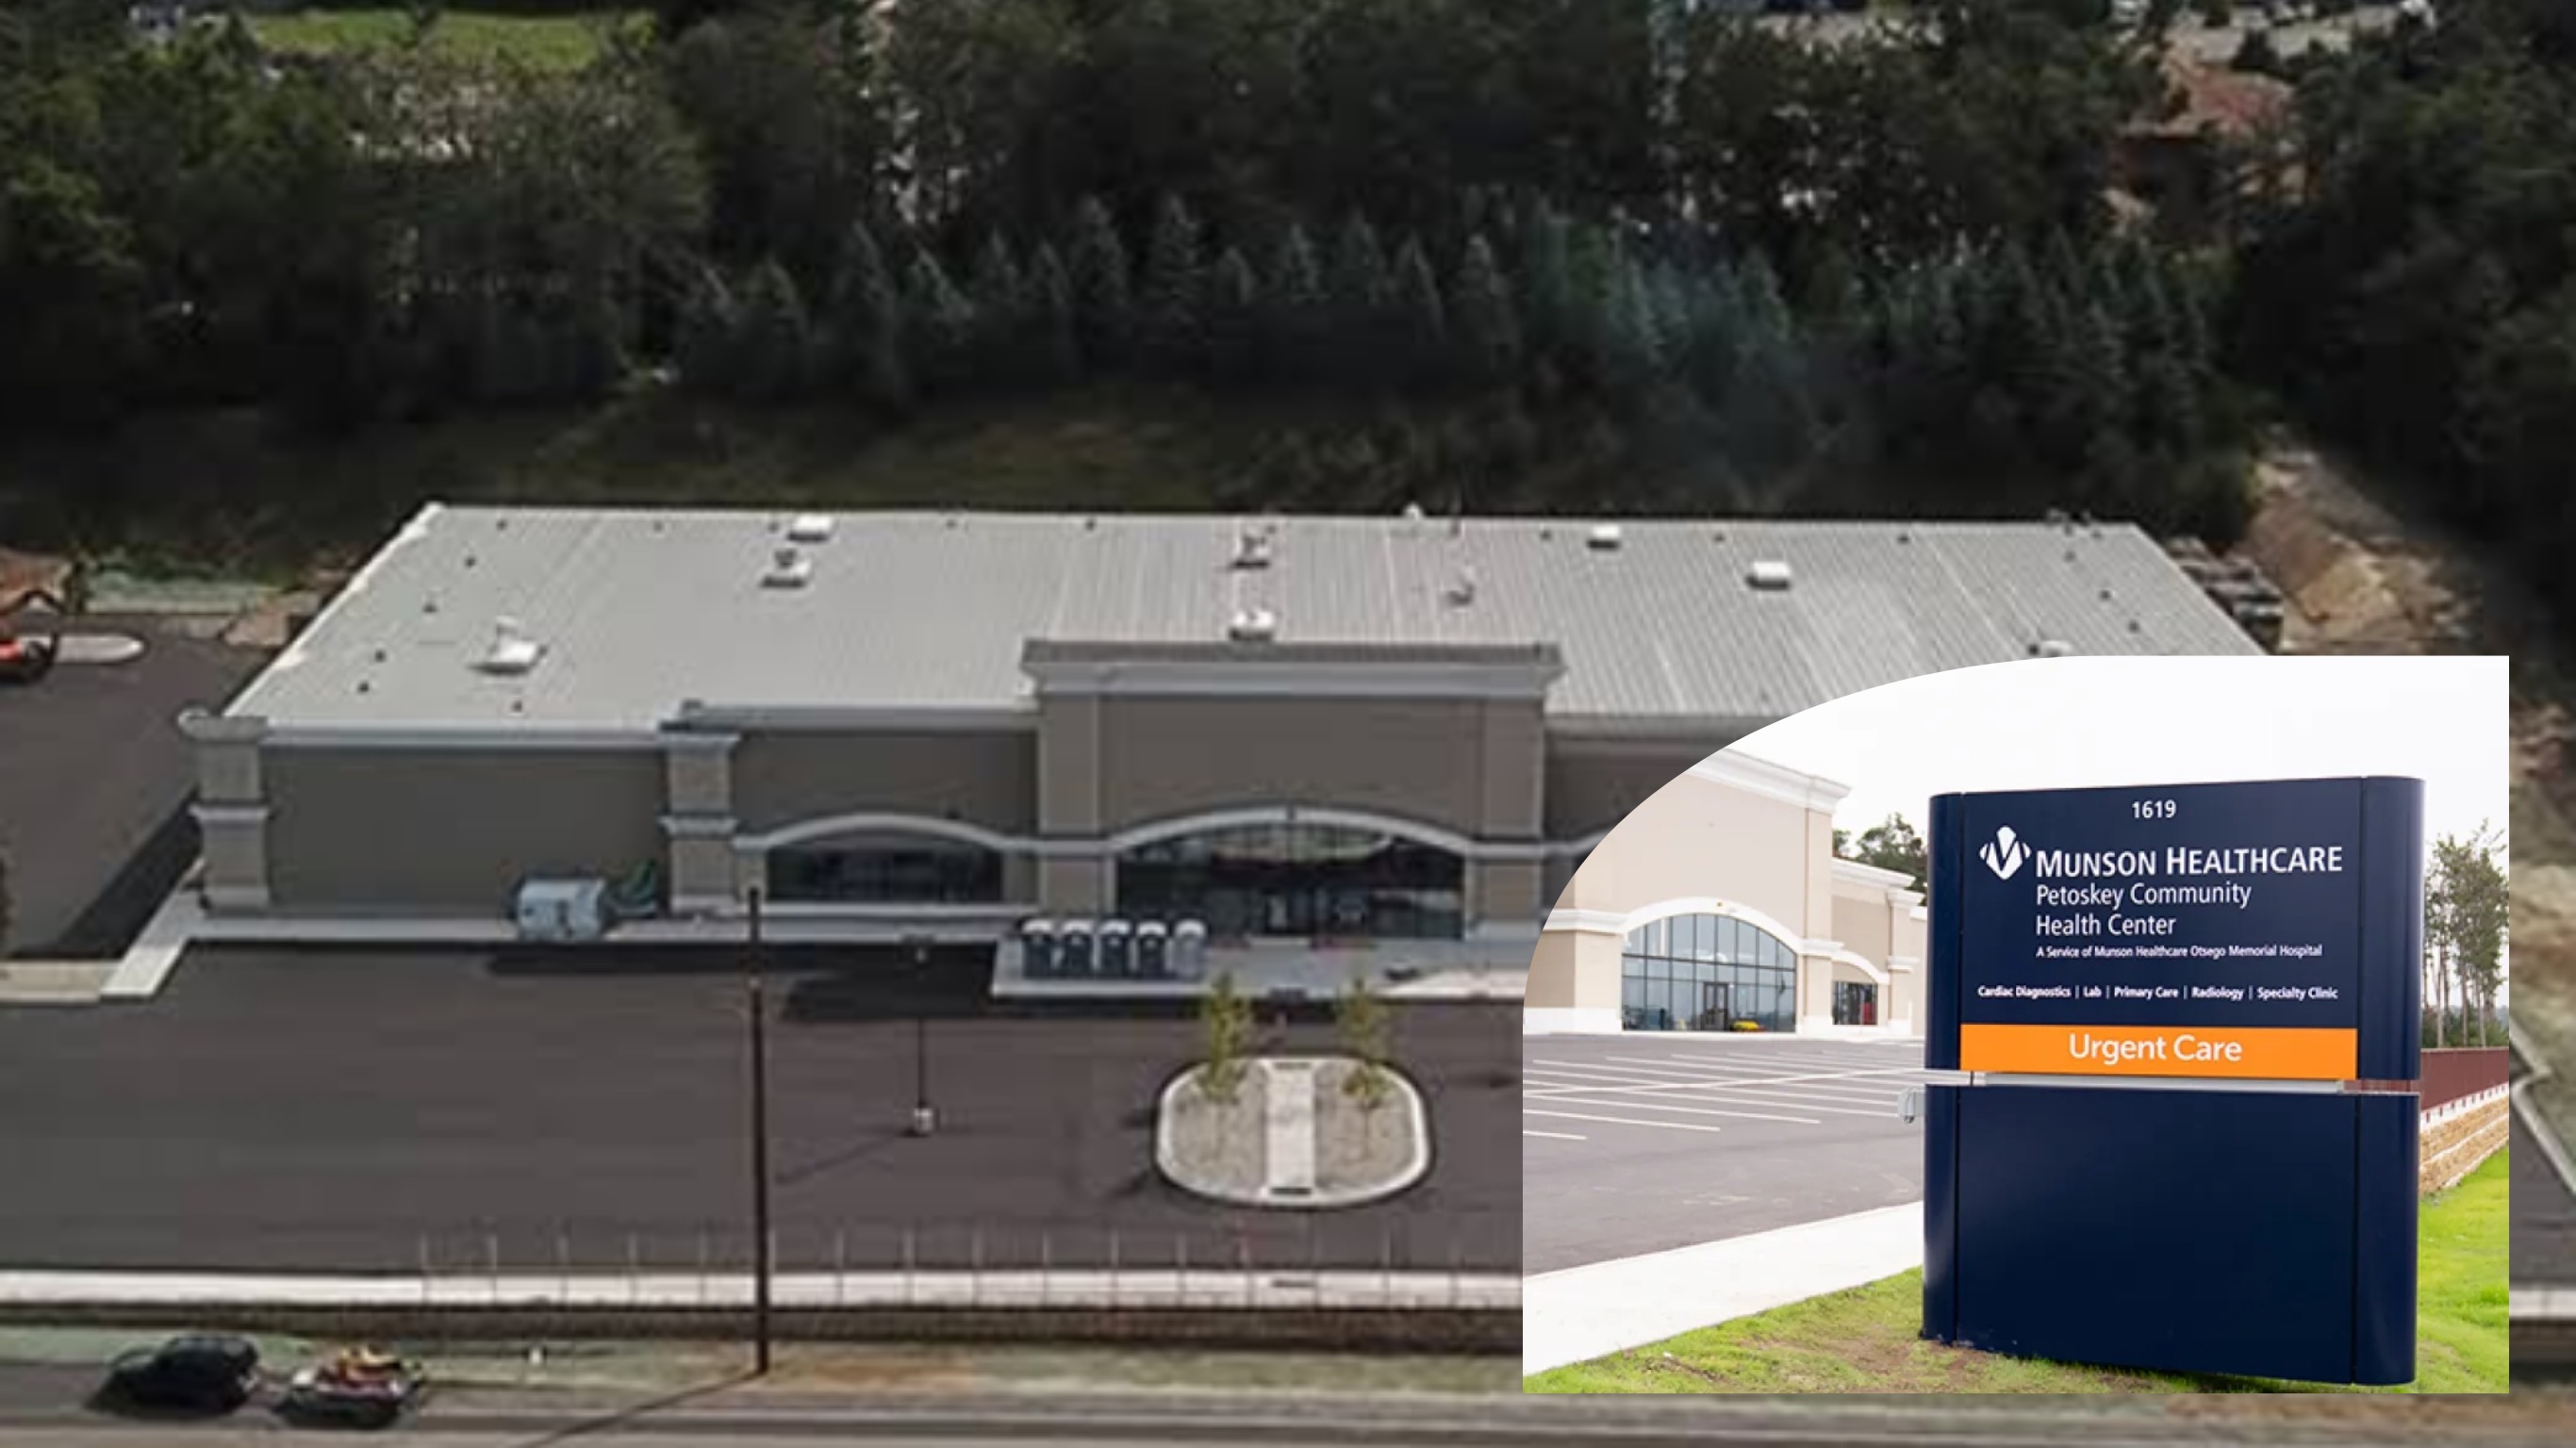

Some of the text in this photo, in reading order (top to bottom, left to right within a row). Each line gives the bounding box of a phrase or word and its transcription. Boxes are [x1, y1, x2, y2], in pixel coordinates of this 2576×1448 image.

[2132, 799, 2177, 819] 1619
[2036, 846, 2343, 878] MUNSON HEALTHCARE
[2037, 881, 2252, 911] Petoskey Community
[2036, 913, 2176, 936] Health Center
[2036, 944, 2323, 960] A Service of Munson Healthcare Otsego Memorial Hospital
[1977, 985, 2338, 1001] Cardiac Diagnostics Lab Primary Care Radiology Specialty Clinic
[2069, 1033, 2243, 1065] Urgent Care
